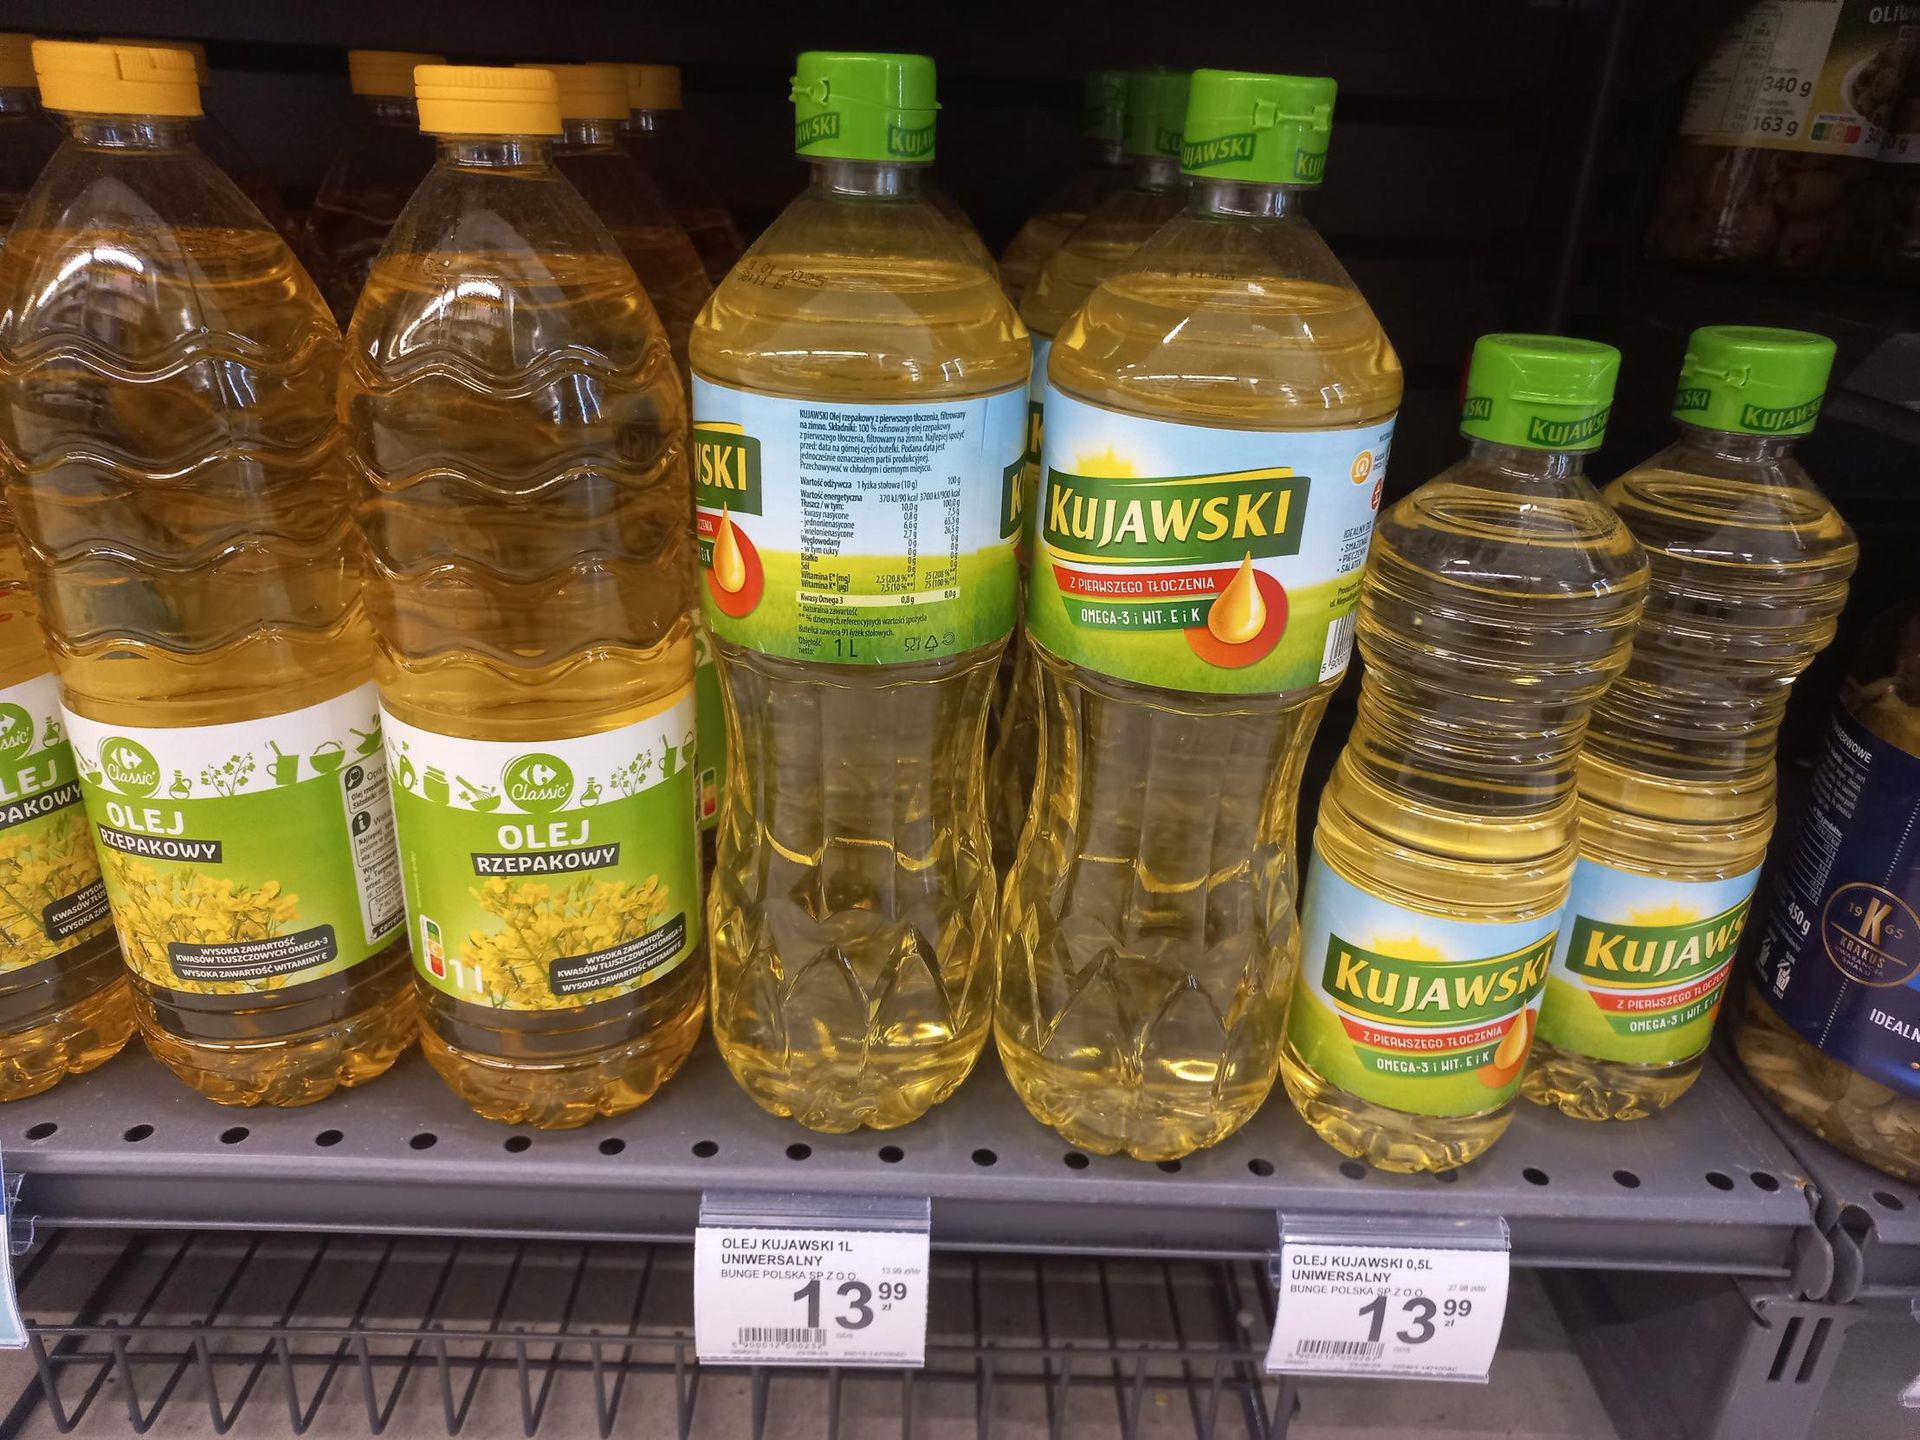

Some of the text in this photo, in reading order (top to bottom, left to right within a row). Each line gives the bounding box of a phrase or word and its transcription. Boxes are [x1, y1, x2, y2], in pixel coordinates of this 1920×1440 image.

[1762, 77, 1812, 98] 340 g
[1753, 116, 1798, 137] 163 g
[1183, 137, 1252, 168] UJAWSKI
[800, 408, 828, 421] KUJAWSKI
[830, 412, 842, 423] Olej
[842, 412, 875, 425] rzepakowy
[880, 414, 912, 425] pierwszego
[940, 411, 966, 422] filtrowany
[804, 431, 837, 443] pierwszego
[865, 434, 897, 445] filtrowany
[828, 423, 858, 432] Składniki:
[859, 424, 871, 433] 100
[878, 423, 911, 434] rafinowany
[911, 423, 922, 433] olej
[923, 421, 950, 433] rzepakowy
[800, 443, 817, 453] przed:
[818, 443, 831, 452] data
[840, 444, 860, 456] górnej
[860, 444, 878, 455] części
[901, 443, 922, 453] Podana
[800, 452, 836, 463] jednocześnie
[837, 454, 875, 464] oznaczeniem
[800, 461, 843, 474] Przechowywać
[800, 477, 900, 492] Wartość odżywcza łyżka stołowa
[800, 489, 823, 500] Wartość
[823, 493, 862, 504] energetyczna
[879, 494, 890, 503] 370
[907, 493, 919, 502] kcal
[822, 511, 850, 521] nasycone
[1049, 483, 1292, 549] KUJAWSKI
[801, 535, 841, 549] Węglowodany
[801, 570, 829, 582] Witamina
[801, 580, 829, 590] Witamina
[1069, 576, 1214, 594] Z PIERWSZEGO TŁOCZENIA
[801, 593, 818, 604] Kwasy
[818, 595, 839, 606] Omega
[1081, 607, 1201, 625] OMEGA-3 WIT. E K
[834, 638, 841, 657] 1
[849, 639, 858, 658] L
[0, 759, 58, 802] LEJ
[107, 763, 156, 787] Classic
[511, 782, 570, 801] Classic
[106, 801, 185, 836] OLEJ
[100, 827, 217, 860] RZEPAKOWY
[497, 819, 590, 850] OLEJ
[476, 847, 616, 874] RZEPAKOWY
[58, 913, 95, 935] WYSOKA
[1788, 902, 1811, 936] 450 g
[1848, 896, 1905, 945] 19 K 65
[175, 936, 328, 965] KWASÓW TŁUSZCZOWYCH OMEGA-3
[200, 936, 296, 958] WYSOKA ZAWARTOŚĆ
[586, 930, 664, 966] WYSOKA ZAWARTOŚĆ
[1583, 910, 1746, 977] KUJAWS
[1840, 936, 1886, 969] KRAKUS
[182, 954, 321, 980] WYSOKA ZAWARTOŚĆ WITAMINY
[557, 963, 599, 978] KWASÓW
[599, 944, 657, 971] TŁUSZCZOWYCH
[448, 959, 464, 989] 1
[562, 979, 600, 992] WYSOKA
[600, 962, 647, 984] ZAWARTOŚĆ
[1334, 944, 1552, 1013] KUJAWSKI
[1627, 991, 1691, 1009] PIERWSZEGO
[1629, 1014, 1677, 1036] OMEGA-3
[1869, 1008, 1920, 1043] IDEALN
[1363, 1025, 1502, 1049] Z PIERWSZEGO TŁOCZENIA
[1377, 1051, 1490, 1076] OMEGA-3 WIT. E K
[722, 1238, 853, 1252] OLEJ KUJAWSKI 1L
[721, 1254, 823, 1267] UNIWERSALNY
[1292, 1255, 1433, 1272] OLEJ KUJAWSKI 0,5L
[721, 1269, 760, 1280] BUNGE
[762, 1270, 806, 1280] POLSKA
[809, 1271, 823, 1280] SP
[826, 1272, 833, 1280] Z
[1292, 1269, 1391, 1283] UNIWERSALNY
[1290, 1285, 1329, 1295] BUNGE
[1331, 1286, 1374, 1296] POLSKA
[1377, 1287, 1391, 1296] SP
[1394, 1288, 1401, 1297] Z
[793, 1280, 907, 1331] 13 99
[882, 1302, 892, 1312] zł
[1358, 1295, 1472, 1345] 13 99
[1444, 1319, 1455, 1328] zł
